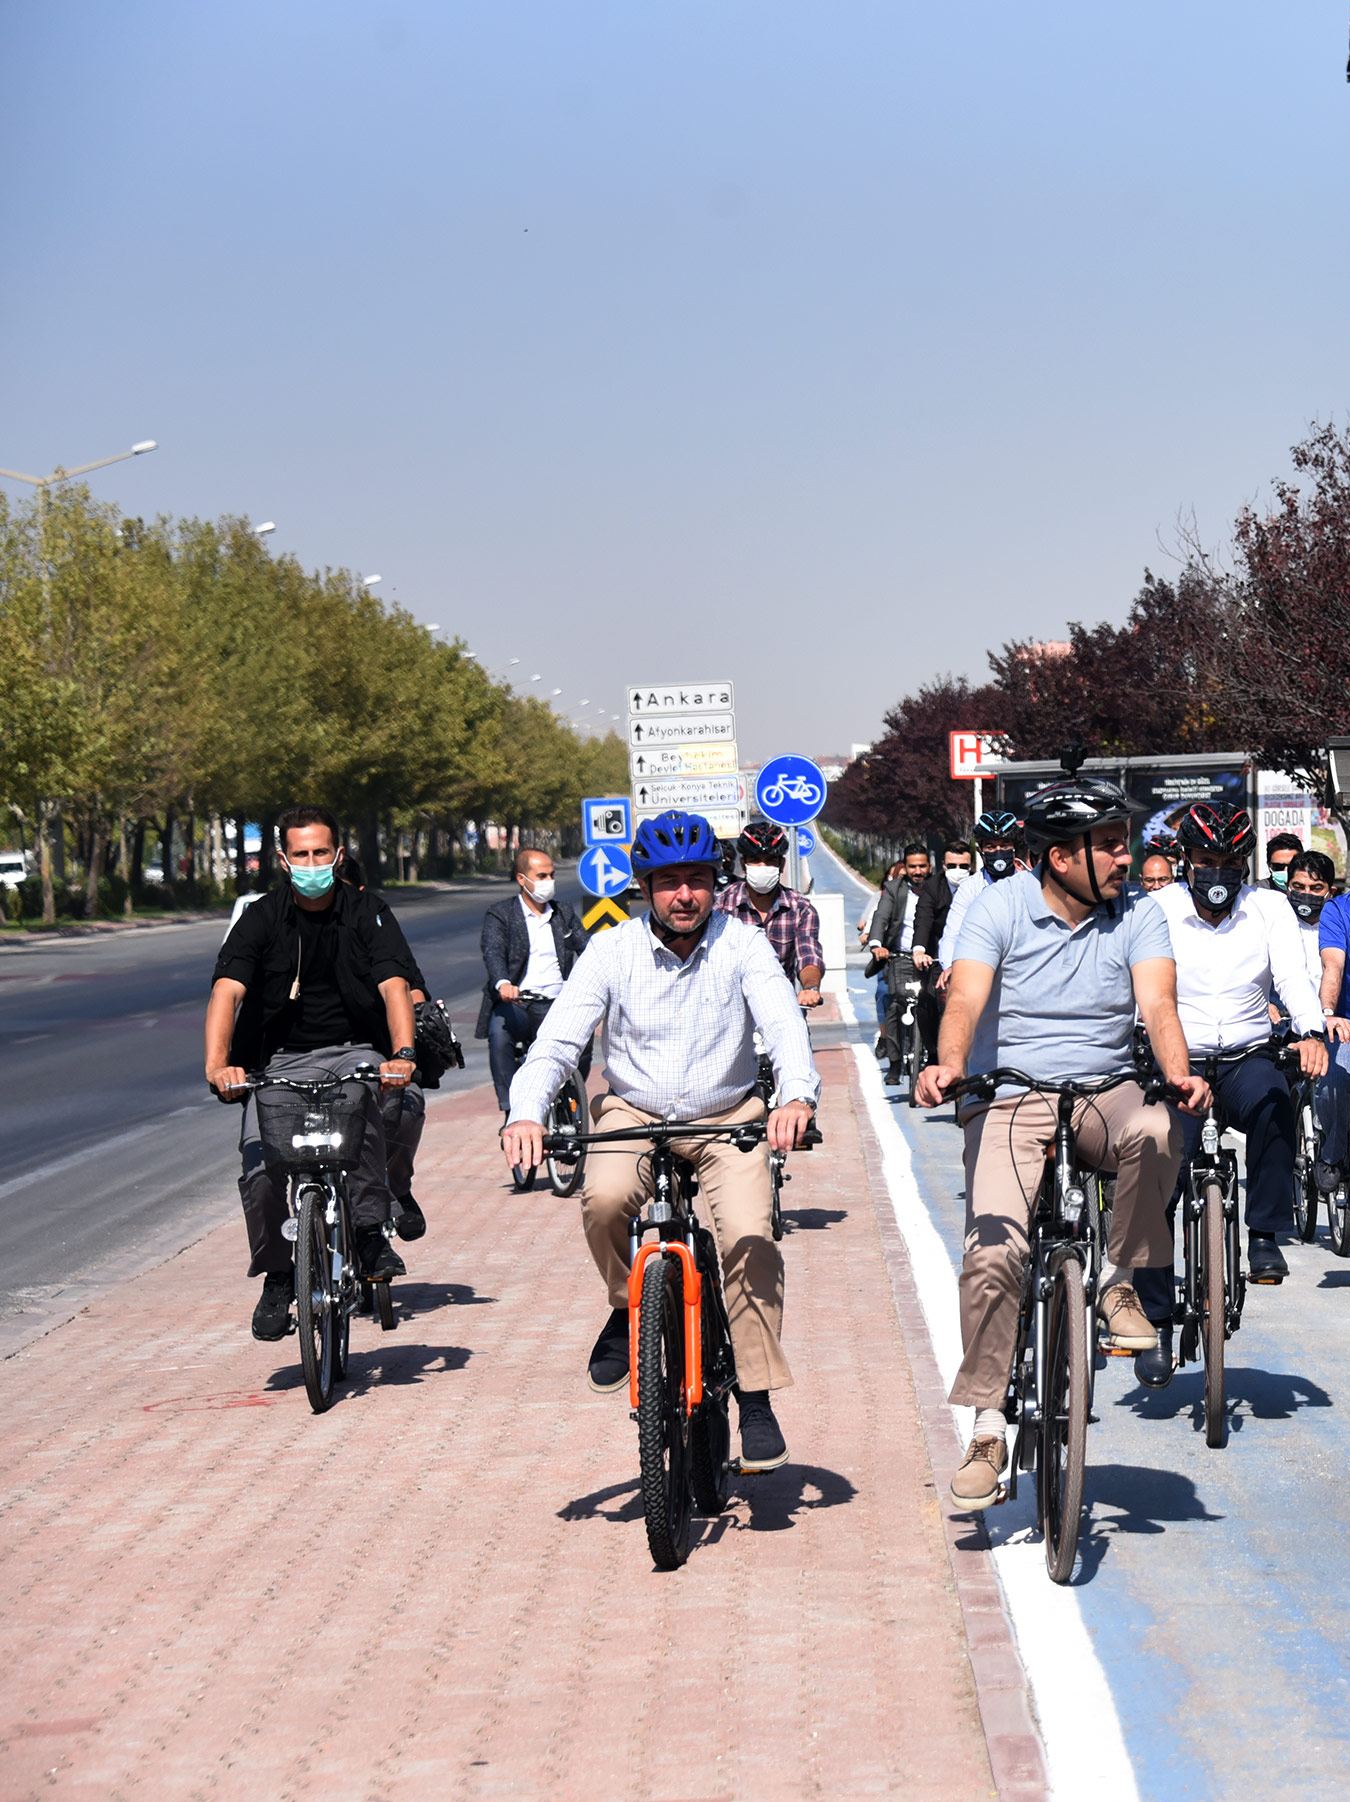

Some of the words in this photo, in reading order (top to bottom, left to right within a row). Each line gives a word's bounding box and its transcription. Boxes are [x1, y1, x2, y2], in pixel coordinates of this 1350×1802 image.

[646, 690, 730, 707] Ankara
[648, 723, 732, 740] Afyonkarahisar
[651, 792, 738, 805] Üniversiteleri
